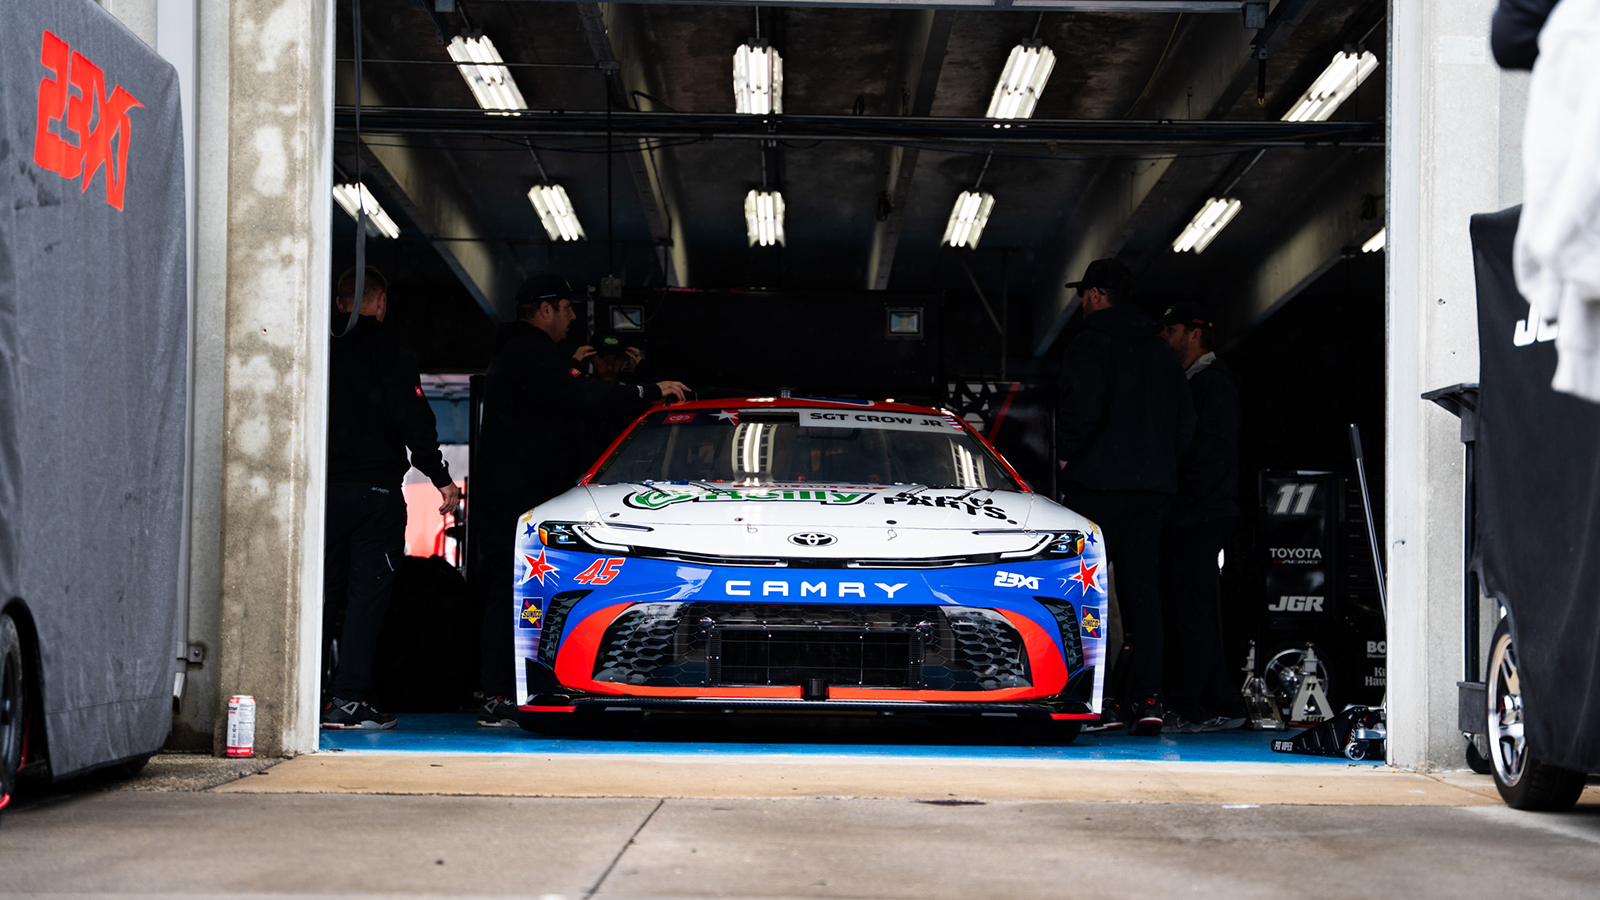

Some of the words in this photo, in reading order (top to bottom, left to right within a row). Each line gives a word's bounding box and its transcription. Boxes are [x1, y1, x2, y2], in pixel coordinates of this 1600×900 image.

[810, 412, 849, 421] SGT
[855, 414, 912, 425] CROW
[920, 419, 944, 427] JR
[1274, 483, 1317, 515] 11
[1269, 548, 1322, 559] TOYOTA
[574, 558, 625, 585] 45
[994, 570, 1044, 590] 23XI
[725, 580, 908, 598] CAMRY
[1268, 596, 1325, 612] JGR
[522, 609, 542, 619] SUNOCO
[1082, 618, 1099, 628] SUNOCO
[1306, 683, 1317, 691] 11
